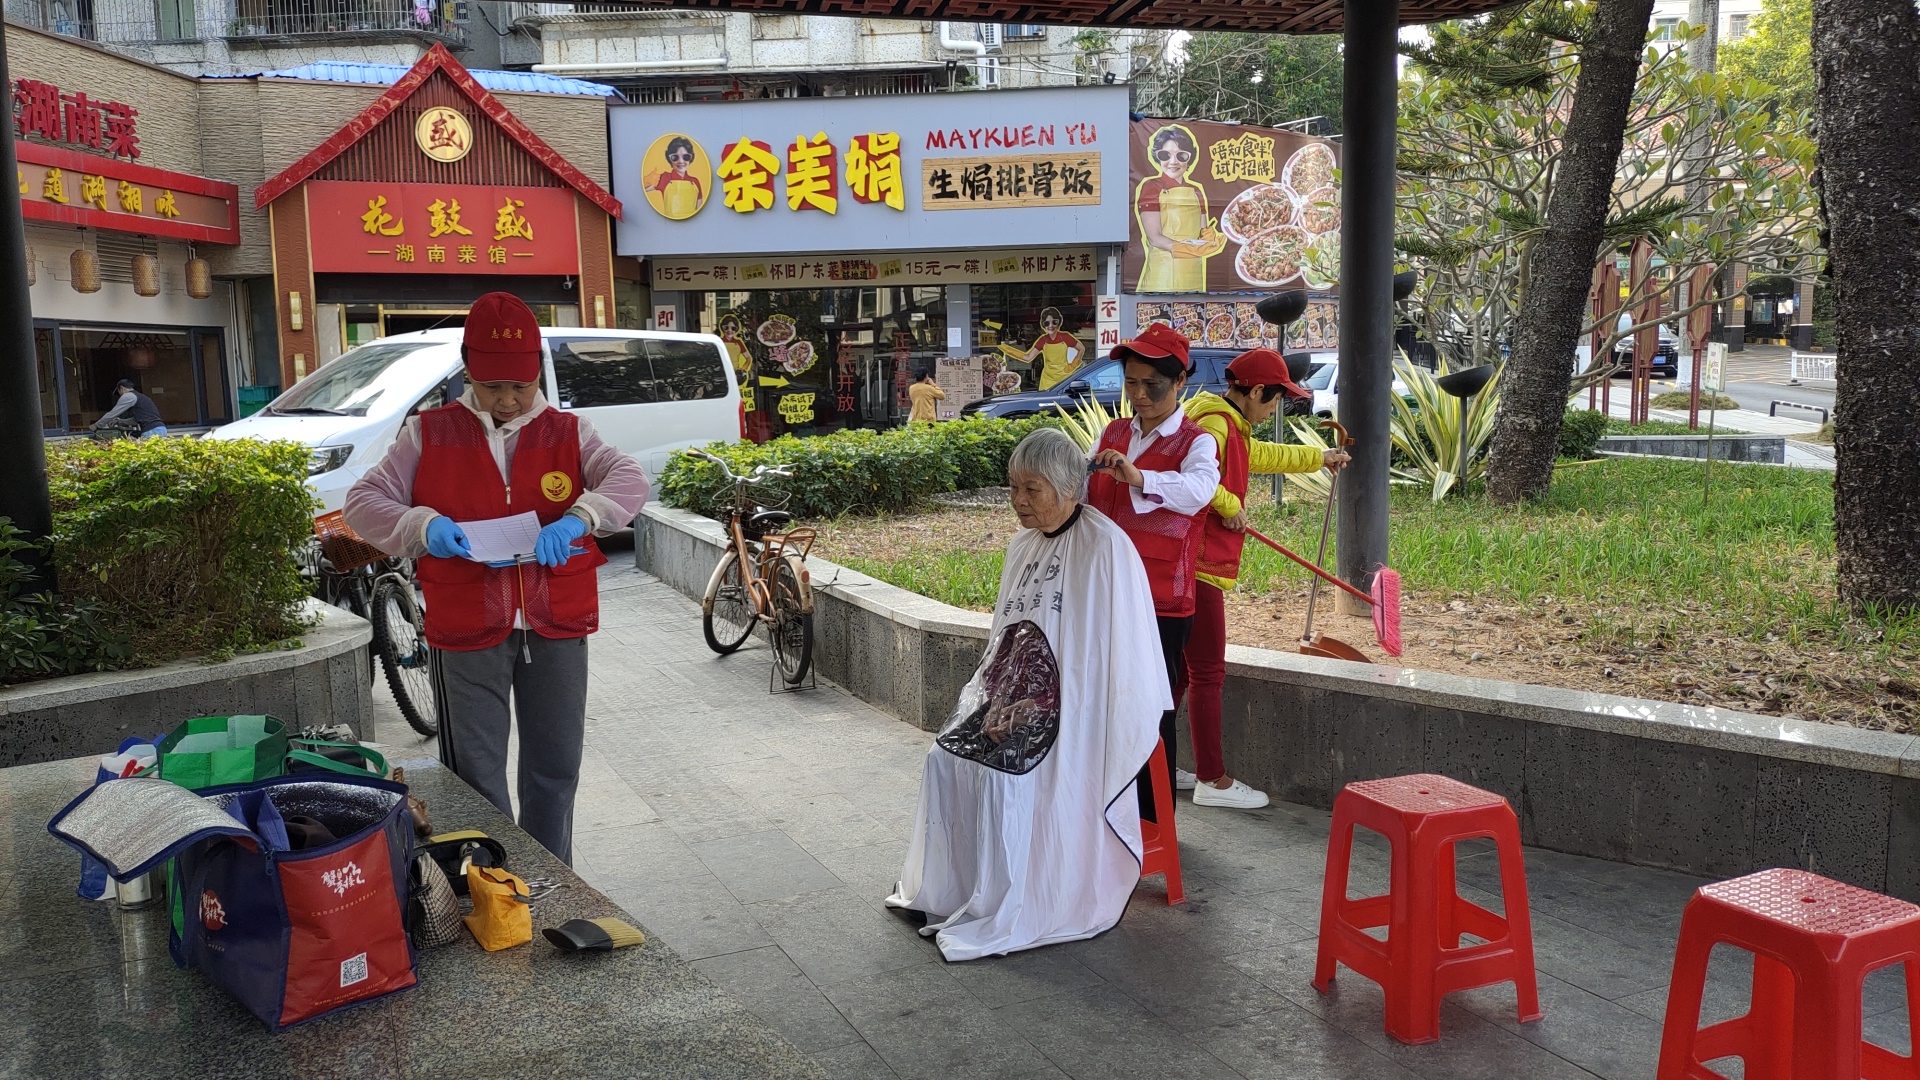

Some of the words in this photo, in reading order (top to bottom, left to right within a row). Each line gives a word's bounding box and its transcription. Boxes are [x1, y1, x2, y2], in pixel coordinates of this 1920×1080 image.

[925, 124, 1055, 150] MAYKUEN
[1065, 123, 1097, 146] YU
[717, 131, 905, 215] 余美娟
[928, 158, 1094, 201] 生焗排骨饭
[361, 195, 534, 241] 花鼓盛
[395, 244, 508, 264] 湖南菜馆
[1022, 253, 1091, 274] 怀旧广东菜
[656, 265, 737, 282] 15元一碟!
[770, 261, 840, 281] 怀旧广东菜
[905, 259, 988, 276] 15元一碟!
[658, 310, 674, 327] 即
[491, 327, 523, 340] 志愿者
